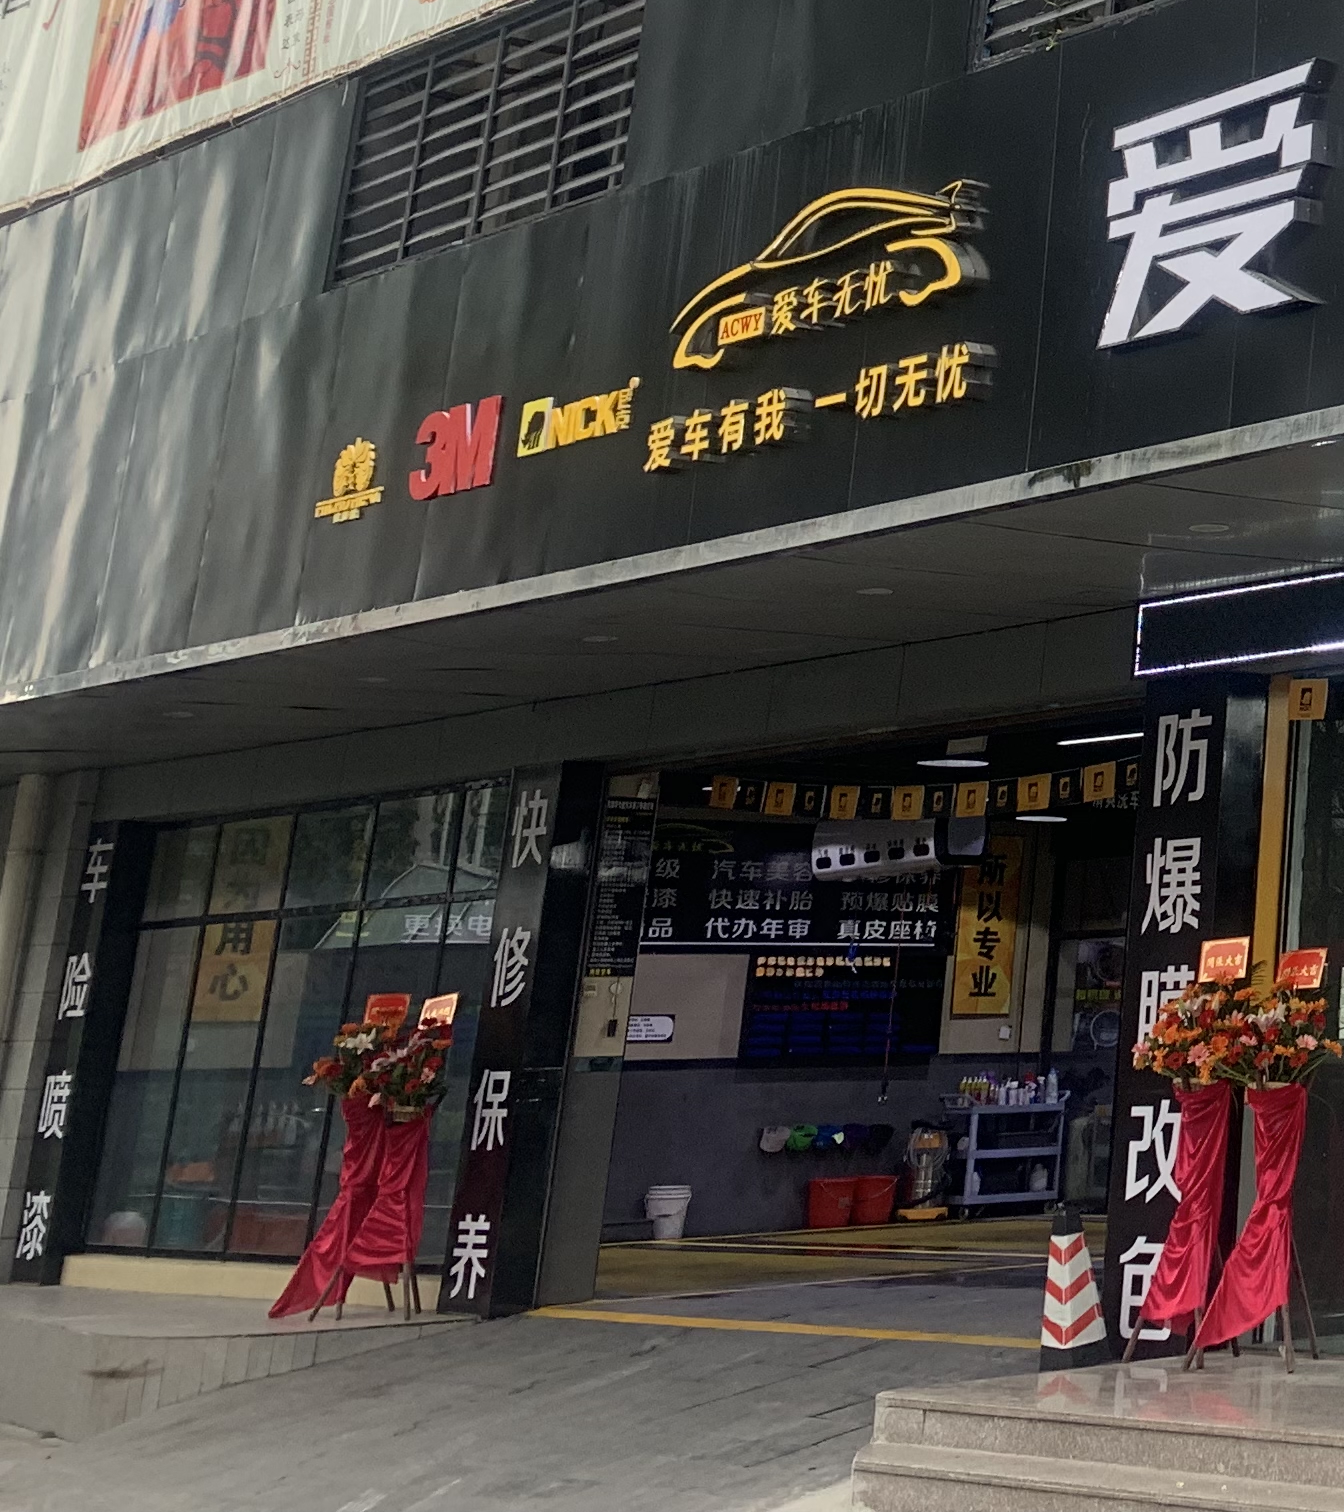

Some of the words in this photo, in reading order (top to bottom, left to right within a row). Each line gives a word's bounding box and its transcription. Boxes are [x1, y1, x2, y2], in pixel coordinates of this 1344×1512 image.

[719, 311, 764, 342] ACWY
[770, 260, 895, 336] 爱车无忧
[408, 395, 504, 501] 3M
[546, 390, 620, 452] NICK
[642, 388, 788, 475] 爱车有我
[814, 341, 973, 422] 一切无忧
[705, 918, 812, 940] 代办年审
[708, 889, 815, 912] 快速补胎
[968, 853, 1008, 998] 所以专业
[15, 837, 114, 1262] 车险喷漆
[449, 789, 549, 1300] 快修保养
